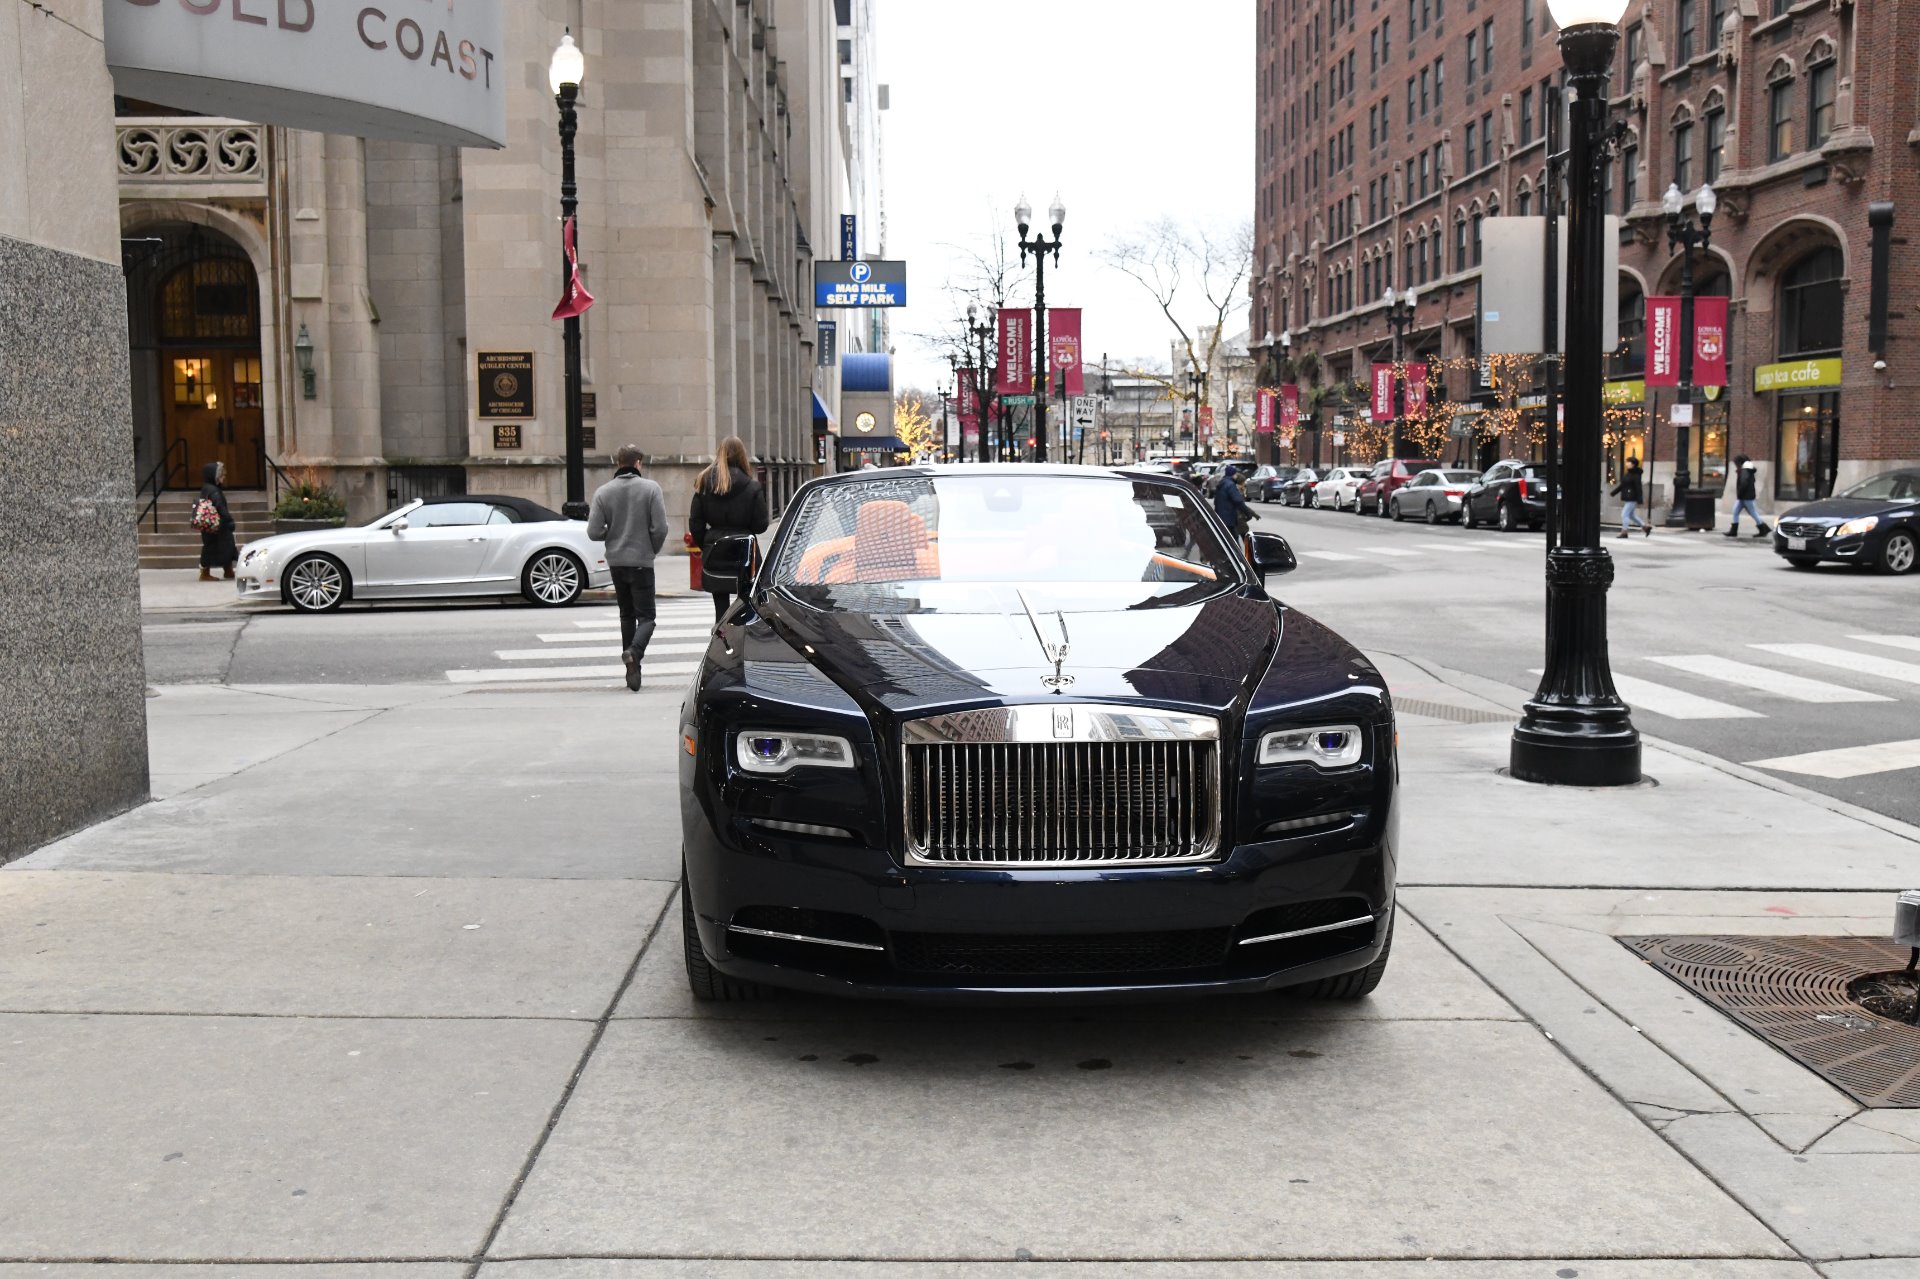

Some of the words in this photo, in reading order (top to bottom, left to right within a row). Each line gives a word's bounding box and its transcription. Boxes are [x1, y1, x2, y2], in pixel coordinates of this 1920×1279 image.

[124, 0, 315, 33] LD
[356, 7, 494, 89] COAST
[835, 284, 860, 293] MAG
[861, 283, 887, 293] MILE
[826, 293, 858, 305] SELF
[860, 293, 895, 305] PARK
[1653, 307, 1665, 375] WELCOME
[1006, 318, 1017, 383] WELCOME
[1791, 361, 1821, 382] café
[1377, 369, 1385, 414] WELCOME
[1008, 396, 1027, 405] RUSH
[1076, 398, 1095, 408] ONE
[1076, 407, 1094, 416] WAY
[498, 426, 517, 437] 835
